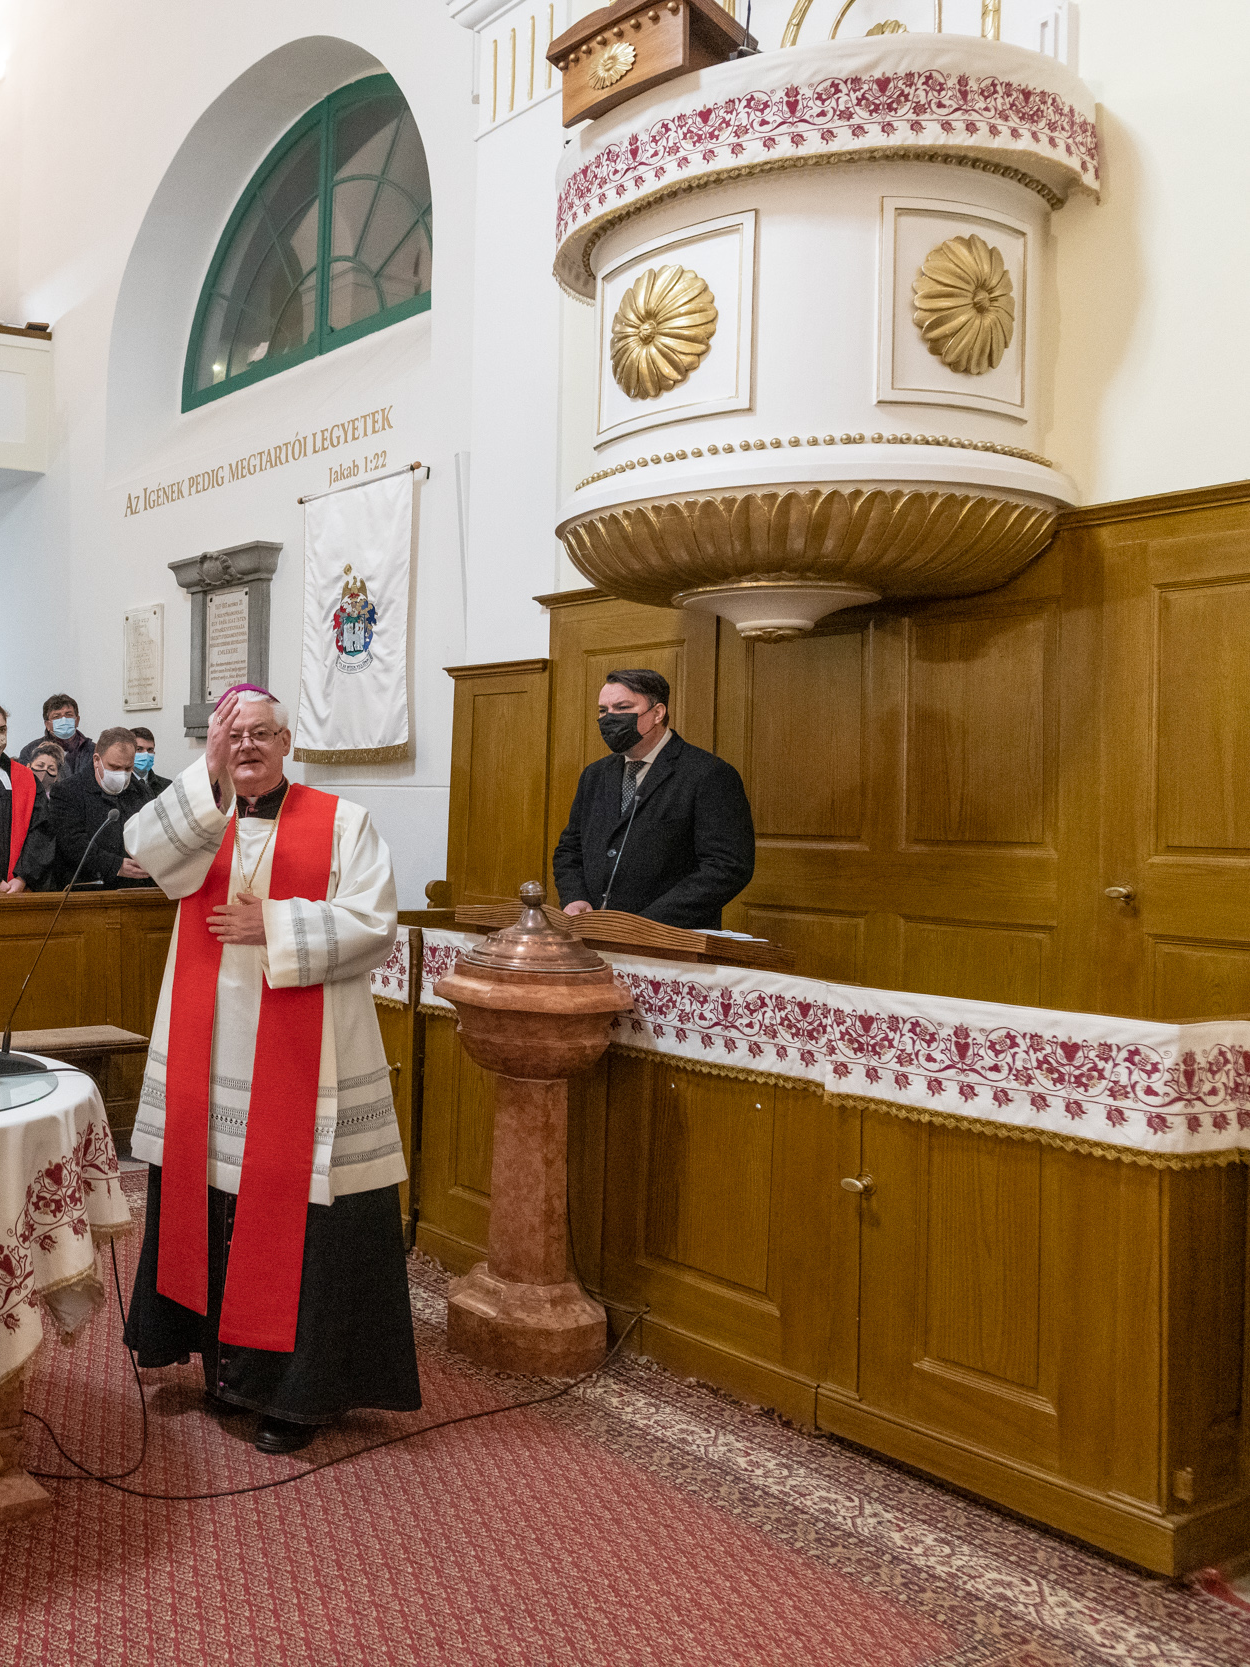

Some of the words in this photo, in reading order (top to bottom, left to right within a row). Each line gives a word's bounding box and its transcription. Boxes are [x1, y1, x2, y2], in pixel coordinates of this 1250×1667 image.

[187, 465, 225, 497] PEDIG
[228, 431, 308, 484] MEGTARTÓI
[311, 405, 394, 455] LEGYETEK
[328, 459, 360, 488] Jakab
[363, 450, 388, 474] 1:22
